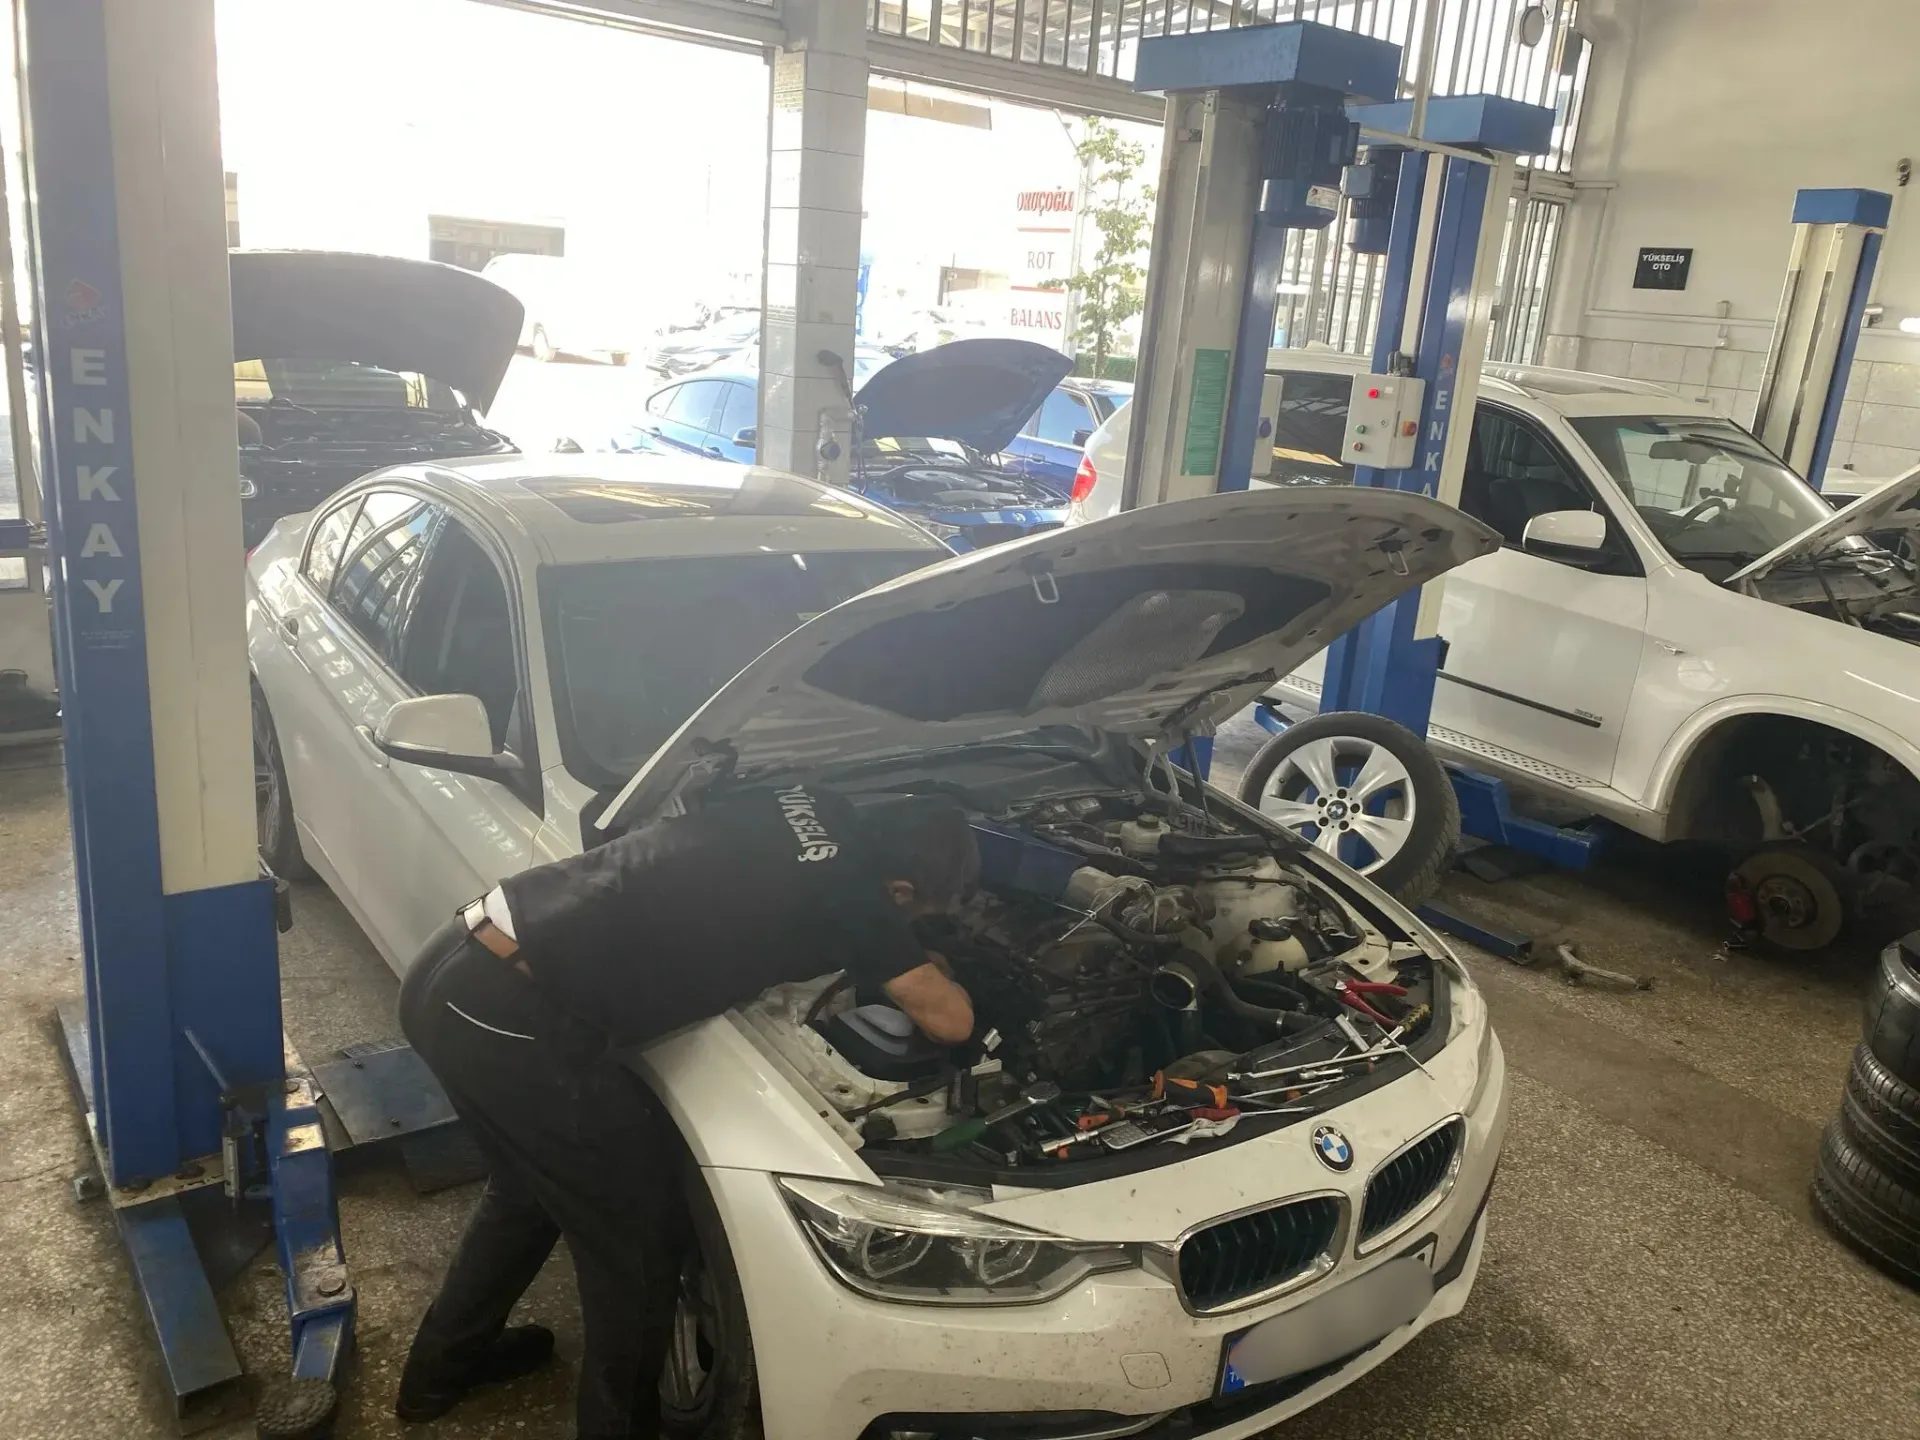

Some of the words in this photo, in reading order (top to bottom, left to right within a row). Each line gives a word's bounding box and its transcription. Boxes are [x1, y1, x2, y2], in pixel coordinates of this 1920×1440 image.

[1027, 250, 1056, 270] ROT
[1642, 253, 1685, 264] YÜKSELİŞ
[1652, 263, 1671, 271] OTO
[1010, 307, 1063, 330] BALANS
[1421, 390, 1449, 498] ENKA
[70, 347, 125, 614] ENKAY
[774, 784, 841, 862] YÜKSELİŞ
